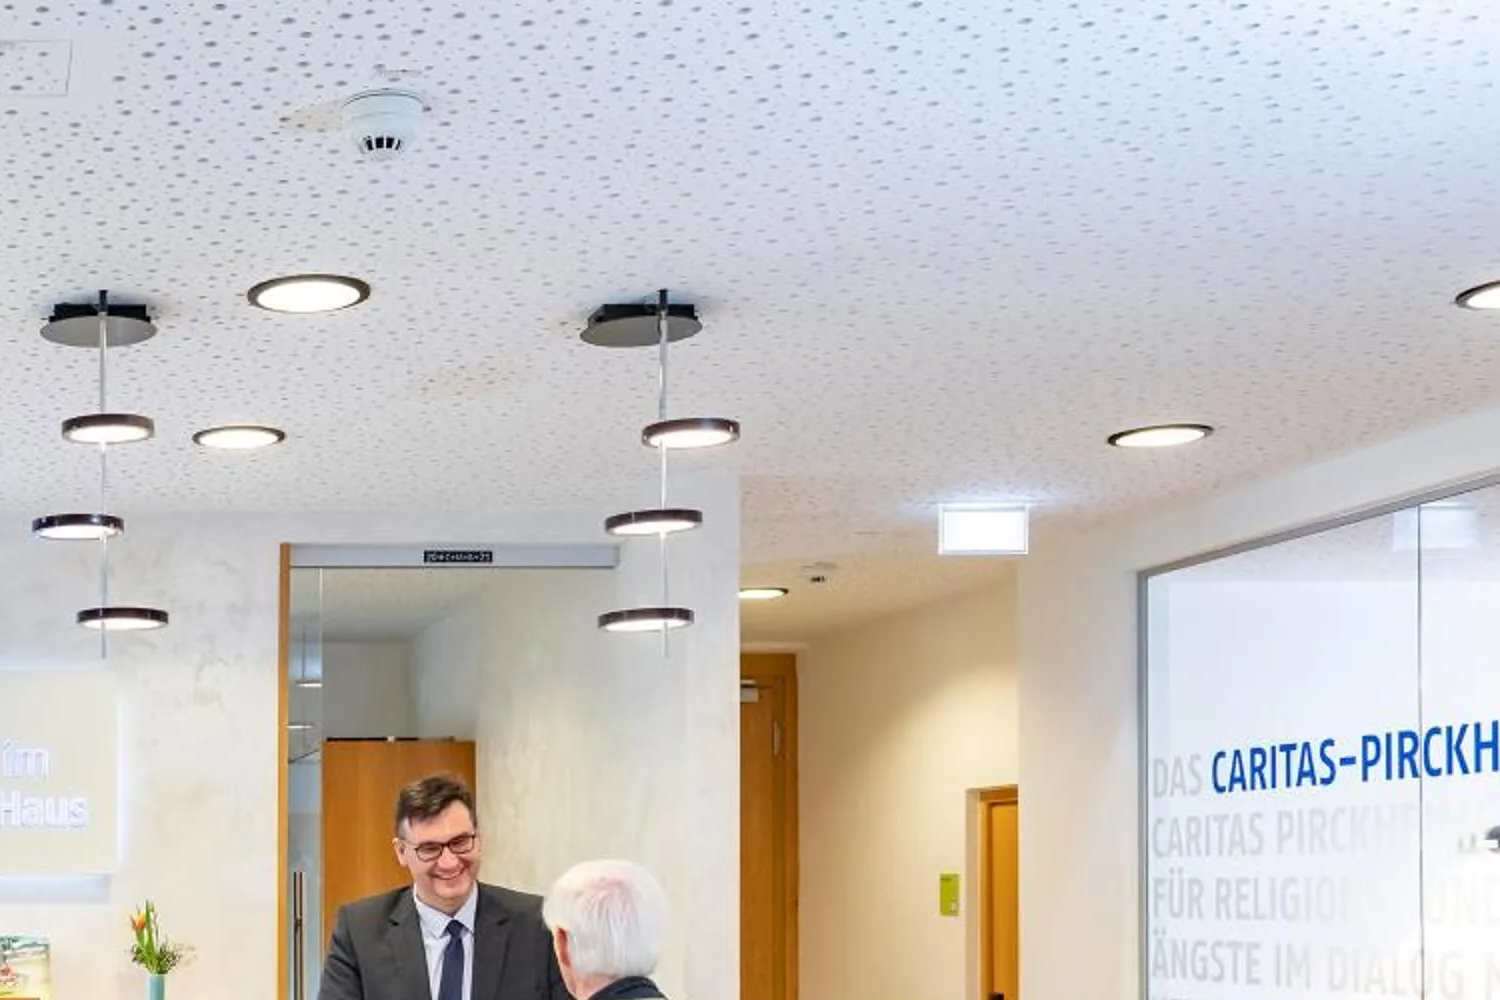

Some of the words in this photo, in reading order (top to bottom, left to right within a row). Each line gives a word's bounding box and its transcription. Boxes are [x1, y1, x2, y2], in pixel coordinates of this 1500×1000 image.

[3, 738, 48, 778] im
[1153, 754, 1202, 798] DAS
[1152, 812, 1264, 858] CARITAS
[1152, 867, 1204, 920] FÜR
[1152, 928, 1262, 986] ÄNGSTE
[1276, 942, 1312, 990] IM
